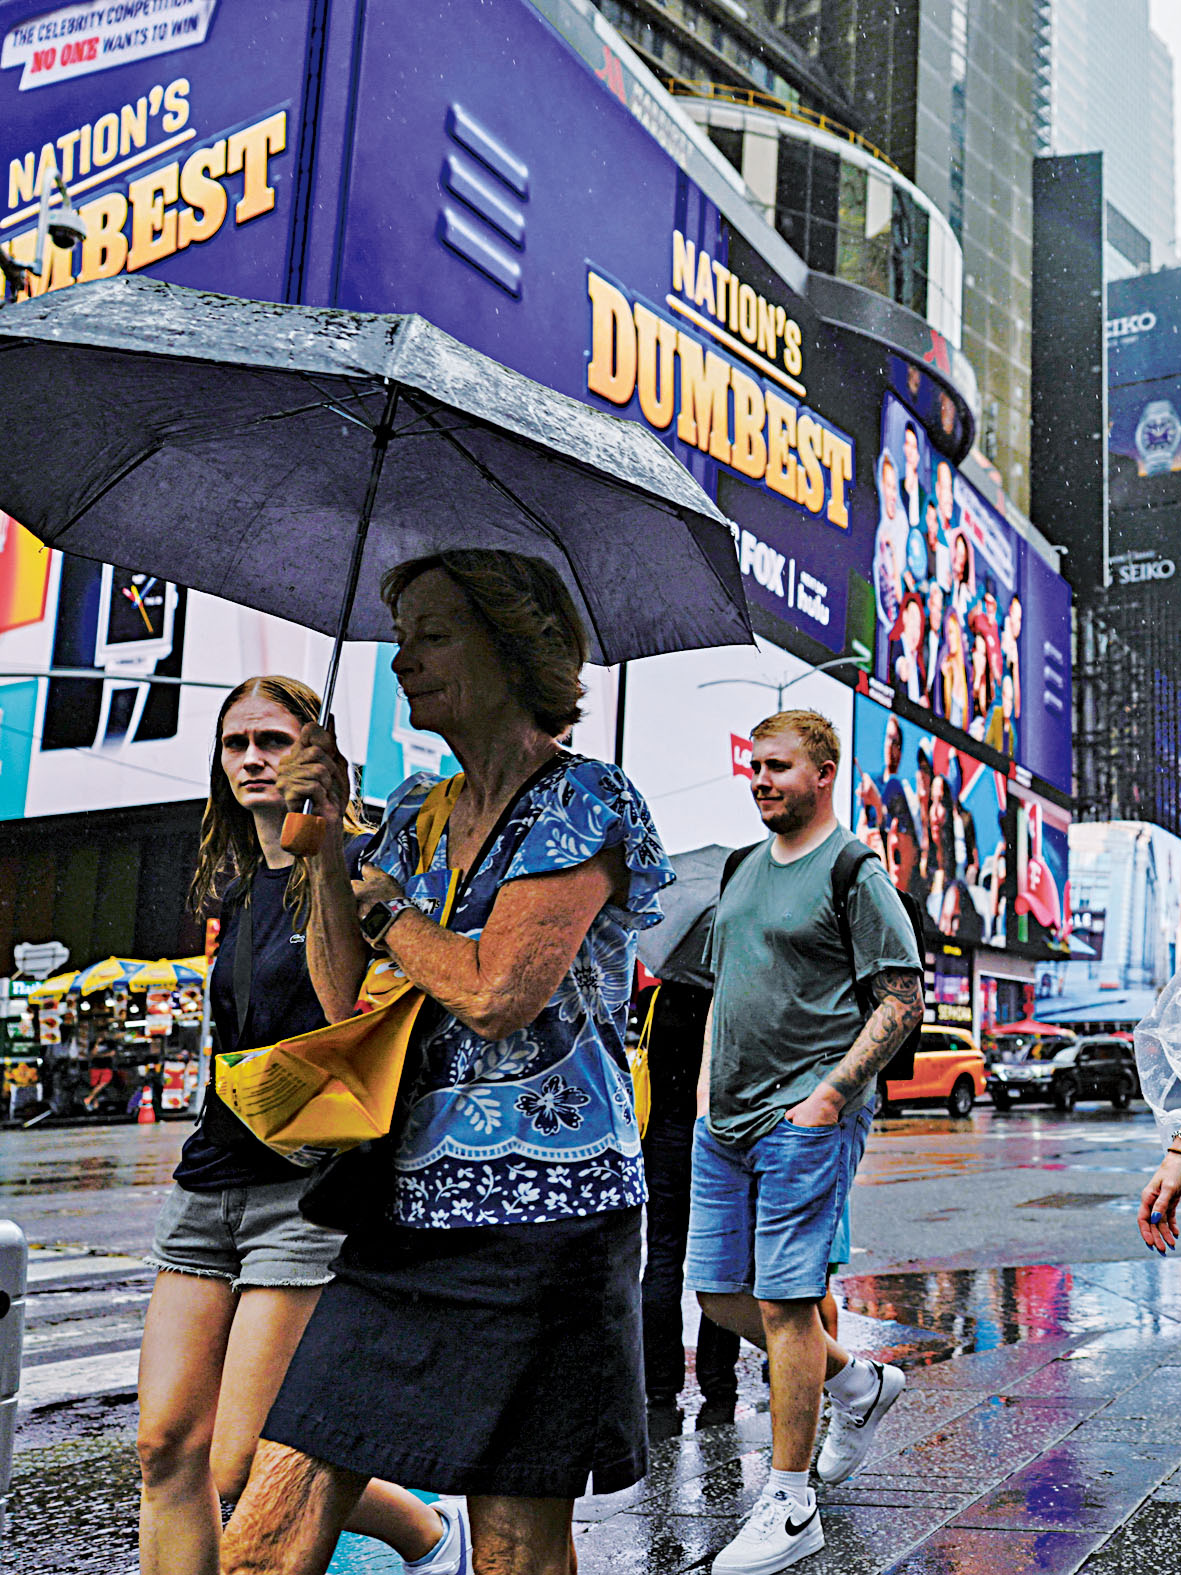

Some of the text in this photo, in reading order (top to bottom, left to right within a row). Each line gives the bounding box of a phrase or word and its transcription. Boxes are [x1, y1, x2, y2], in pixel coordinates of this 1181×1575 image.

[12, 25, 36, 47] THE
[37, 8, 105, 42] CELEBRITY
[30, 13, 200, 74] NO ONE WANTS TO WIN
[7, 77, 191, 209] NATION'S
[672, 228, 803, 376] NATION'S
[586, 270, 853, 529] DUMBEST
[740, 529, 786, 598] FOX
[1118, 559, 1176, 585] SEIKO
